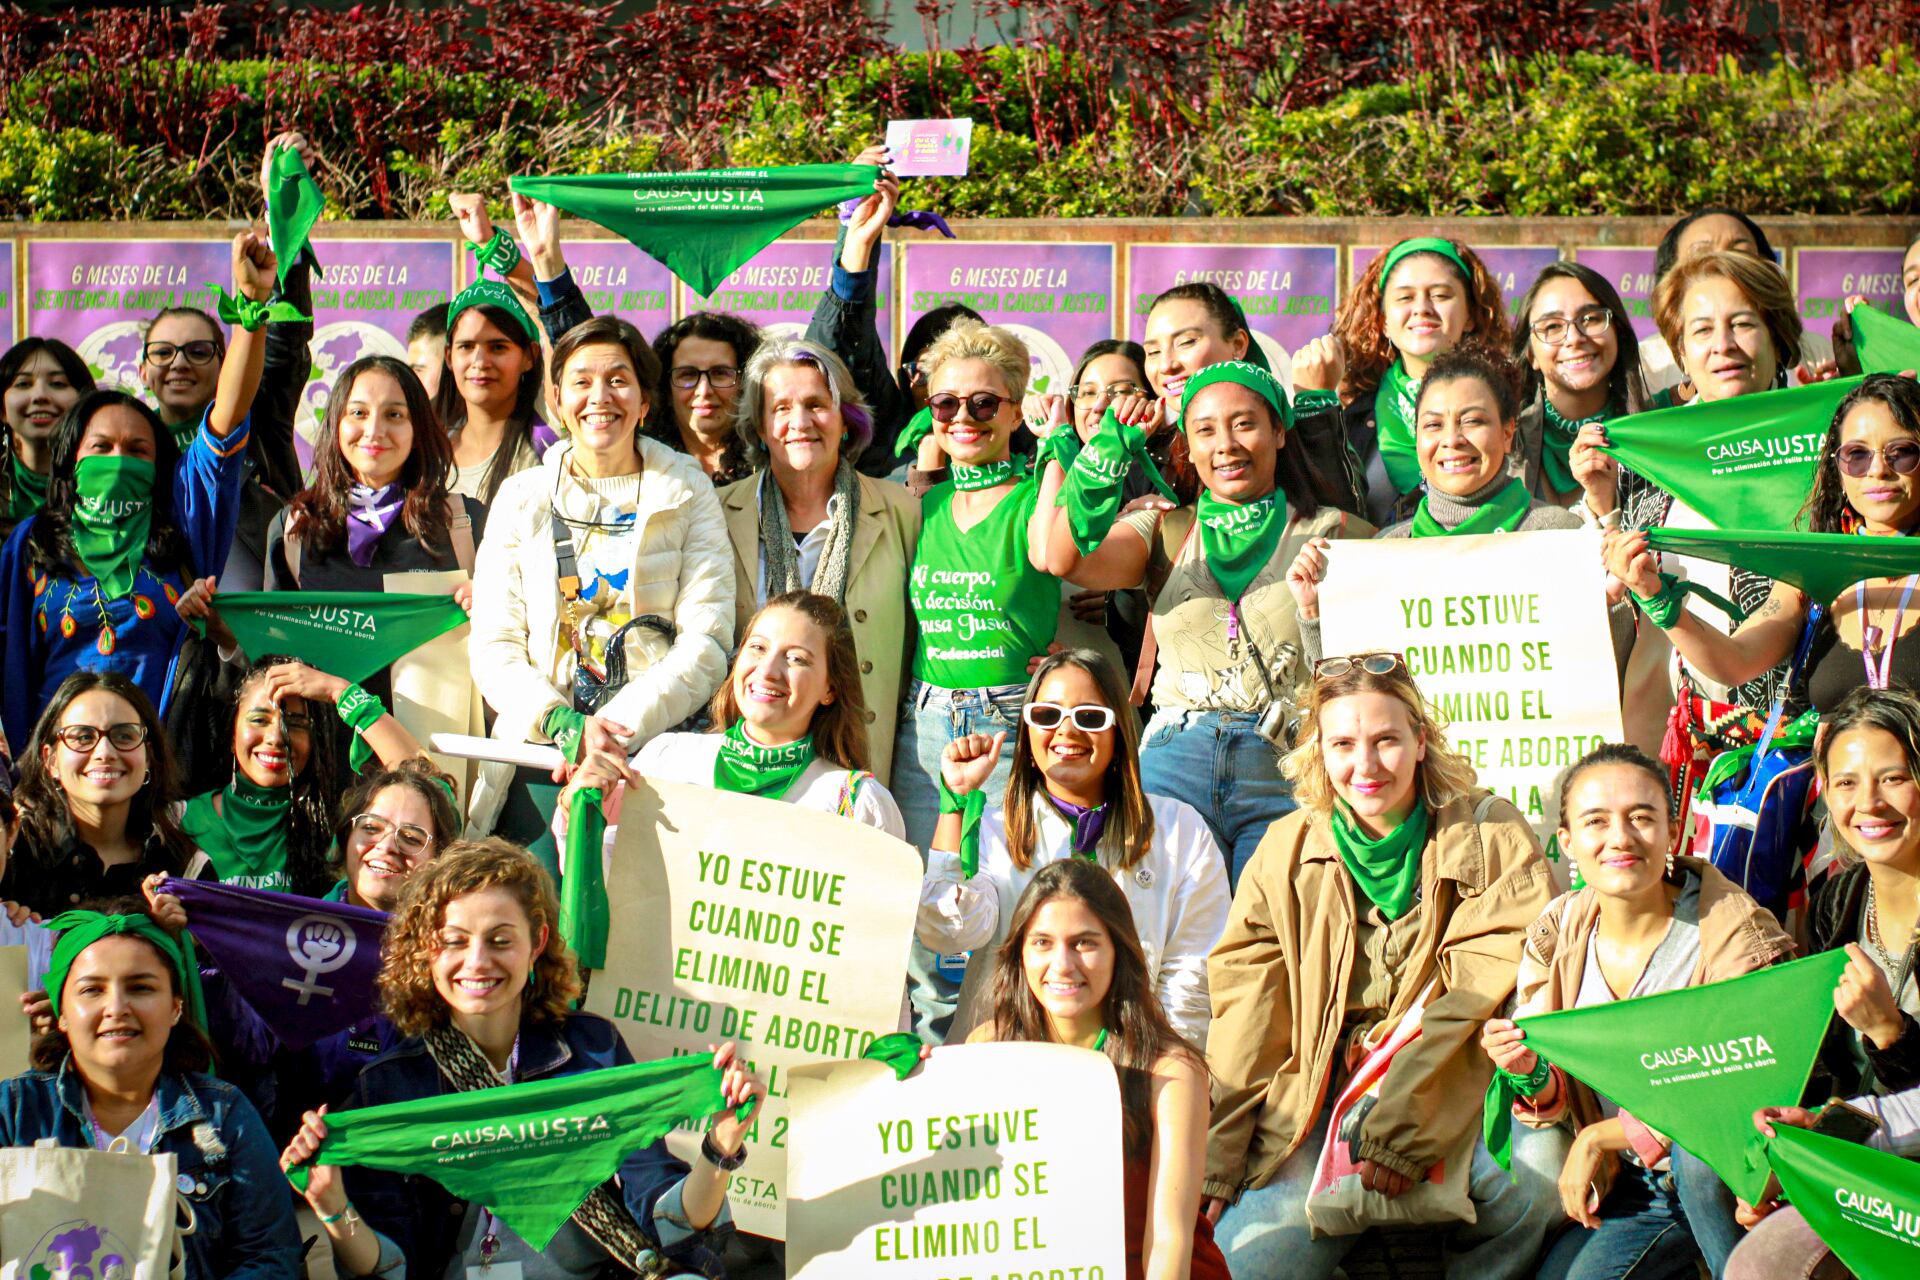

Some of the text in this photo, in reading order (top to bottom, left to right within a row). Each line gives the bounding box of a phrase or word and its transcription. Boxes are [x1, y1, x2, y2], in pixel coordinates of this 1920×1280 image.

[72, 265, 187, 285] 6 MESES DE LA
[362, 265, 385, 285] DE
[388, 265, 408, 285] LA
[582, 266, 602, 286] DE
[607, 266, 627, 286] LA
[730, 267, 740, 286] 6
[744, 267, 796, 286] MESES
[801, 267, 823, 286] DE
[950, 267, 1067, 288] 6 MESES DE LA
[1246, 271, 1268, 290] DE
[1271, 271, 1291, 290] LA
[1621, 273, 1632, 292] 6
[1842, 273, 1854, 293] 6
[33, 288, 119, 310] SENTENCIA
[123, 290, 174, 310] CAUSA
[344, 289, 395, 311] CAUSA
[618, 291, 667, 311] JUSTA
[1003, 292, 1053, 313] CAUSA
[1058, 293, 1106, 313] JUSTA
[1282, 295, 1329, 315] JUSTA
[1734, 461, 1771, 472] eliminación
[1784, 456, 1803, 464] delito
[931, 570, 996, 592] cuerpo,
[925, 590, 1002, 611] decisión.
[1400, 594, 1540, 629] YO ESTUVE
[275, 613, 311, 627] eliminación
[313, 621, 324, 629] del
[325, 622, 343, 633] delito
[344, 626, 353, 635] de
[354, 629, 375, 641] aborto
[1405, 641, 1553, 677] CUANDO SE
[1433, 689, 1552, 723] IMINO EL
[698, 850, 846, 907] YO ESTUVE
[689, 900, 845, 956] CUANDO SE
[674, 947, 831, 1005] ELIMINO EL
[613, 987, 711, 1034] DELITO
[720, 1006, 757, 1043] DE
[763, 1014, 877, 1060] ABORTO
[1650, 1078, 1662, 1086] Por
[1672, 1070, 1710, 1082] eliminación
[1711, 1068, 1723, 1076] del
[1723, 1064, 1743, 1073] delito
[1754, 1057, 1777, 1067] aborto
[539, 1137, 564, 1147] delito
[567, 1135, 578, 1143] de
[582, 1131, 611, 1141] aborto
[878, 1108, 1039, 1154] YO ESTUVE
[880, 1161, 1049, 1210] CUANDO SE
[743, 1197, 752, 1205] de
[753, 1199, 777, 1210] aborto
[875, 1216, 1047, 1262] ELIMINO EL
